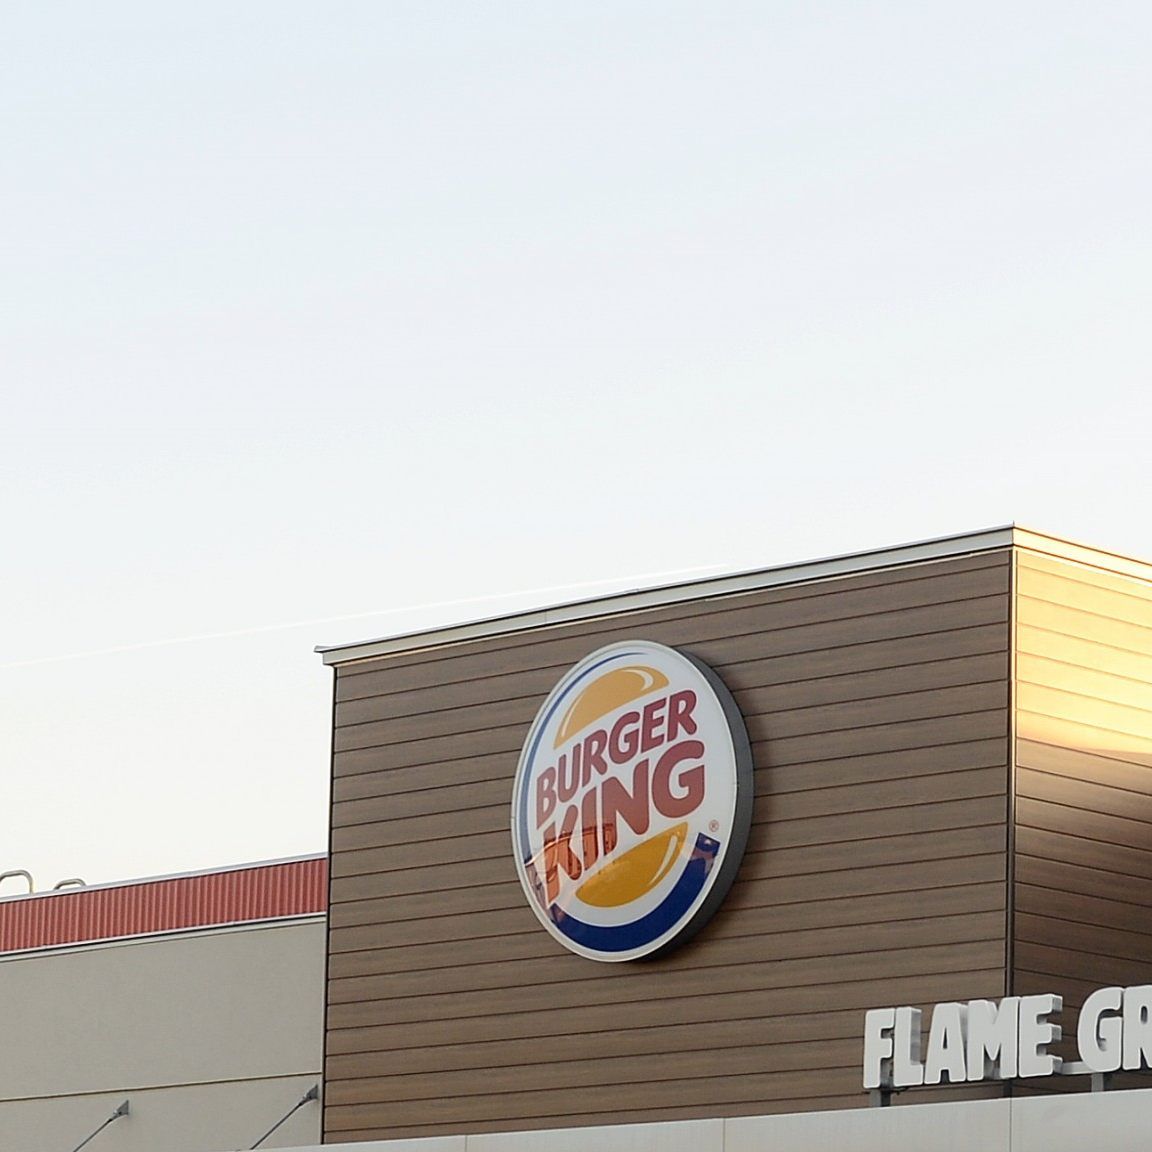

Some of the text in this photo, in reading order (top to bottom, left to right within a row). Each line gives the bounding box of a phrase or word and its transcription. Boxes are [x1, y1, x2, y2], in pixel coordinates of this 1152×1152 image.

[536, 690, 698, 830] BURGER
[543, 740, 706, 909] KING
[863, 993, 1063, 1089] FLAME
